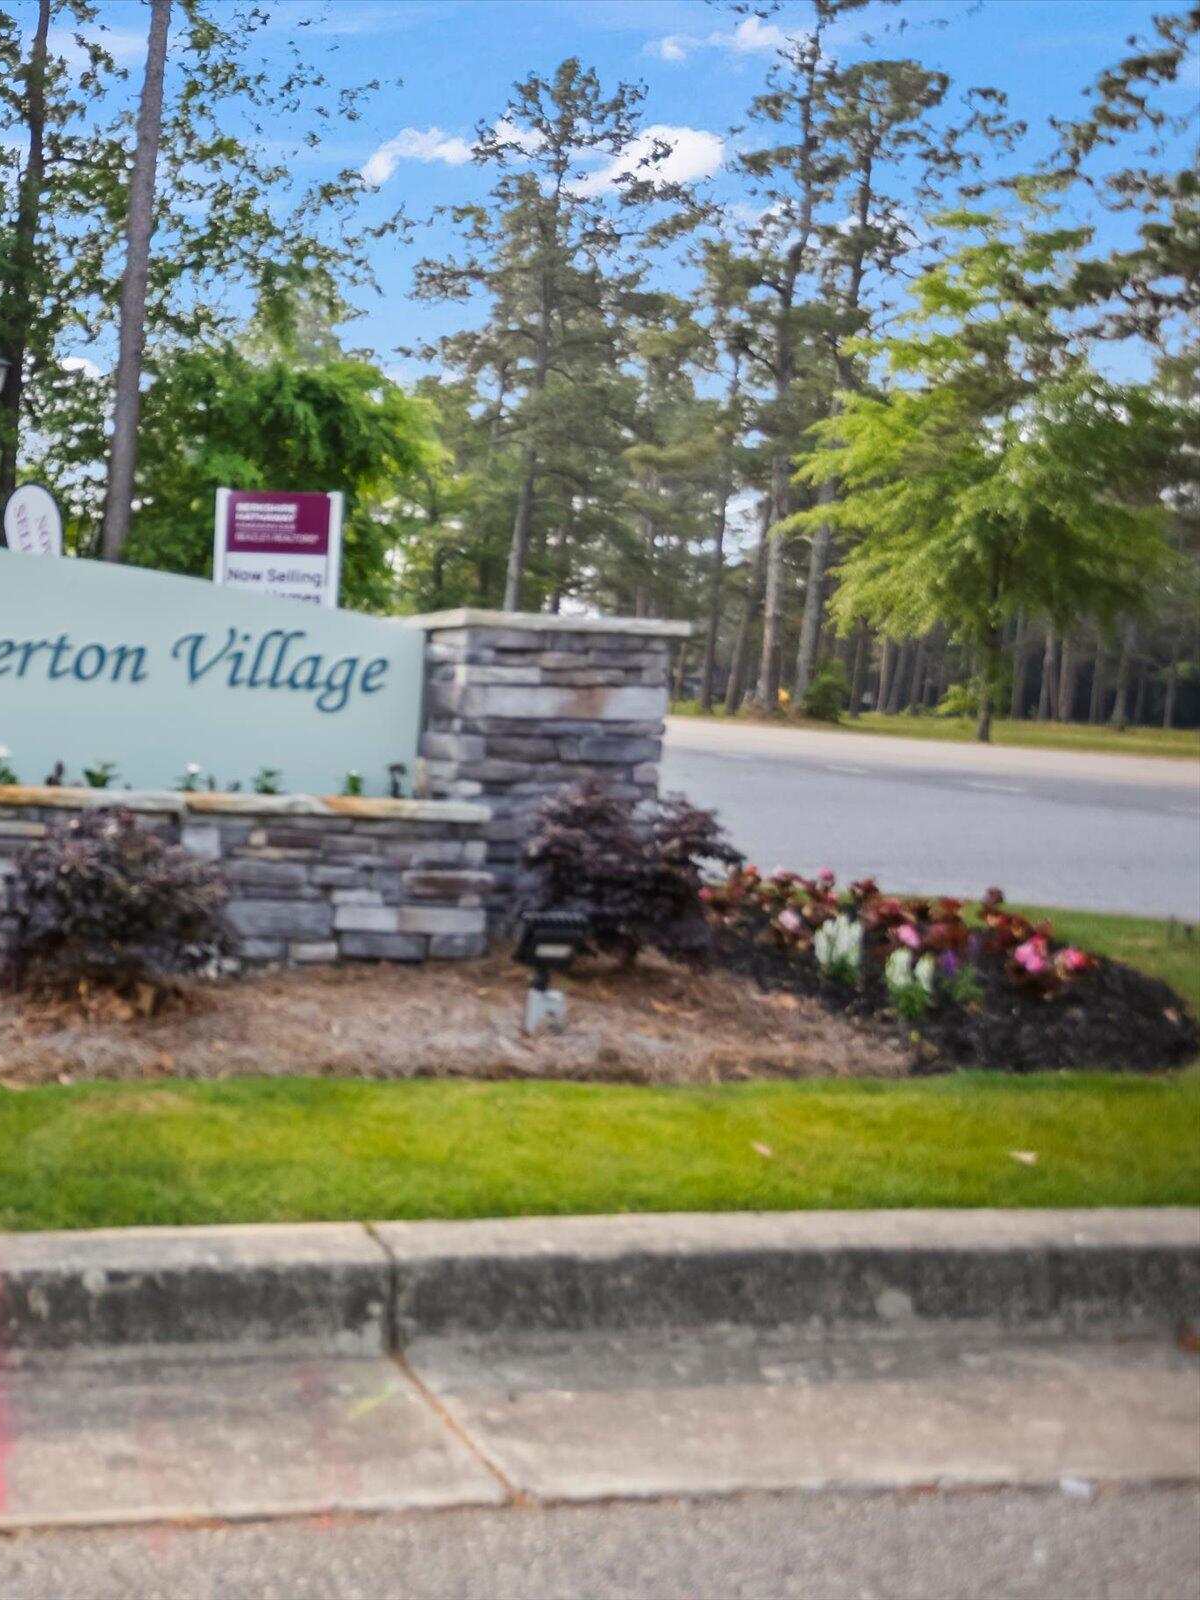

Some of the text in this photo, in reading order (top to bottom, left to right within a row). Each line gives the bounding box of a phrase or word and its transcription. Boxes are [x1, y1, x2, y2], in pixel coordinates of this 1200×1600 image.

[228, 568, 322, 588] Now Selling
[171, 628, 390, 713] Village
